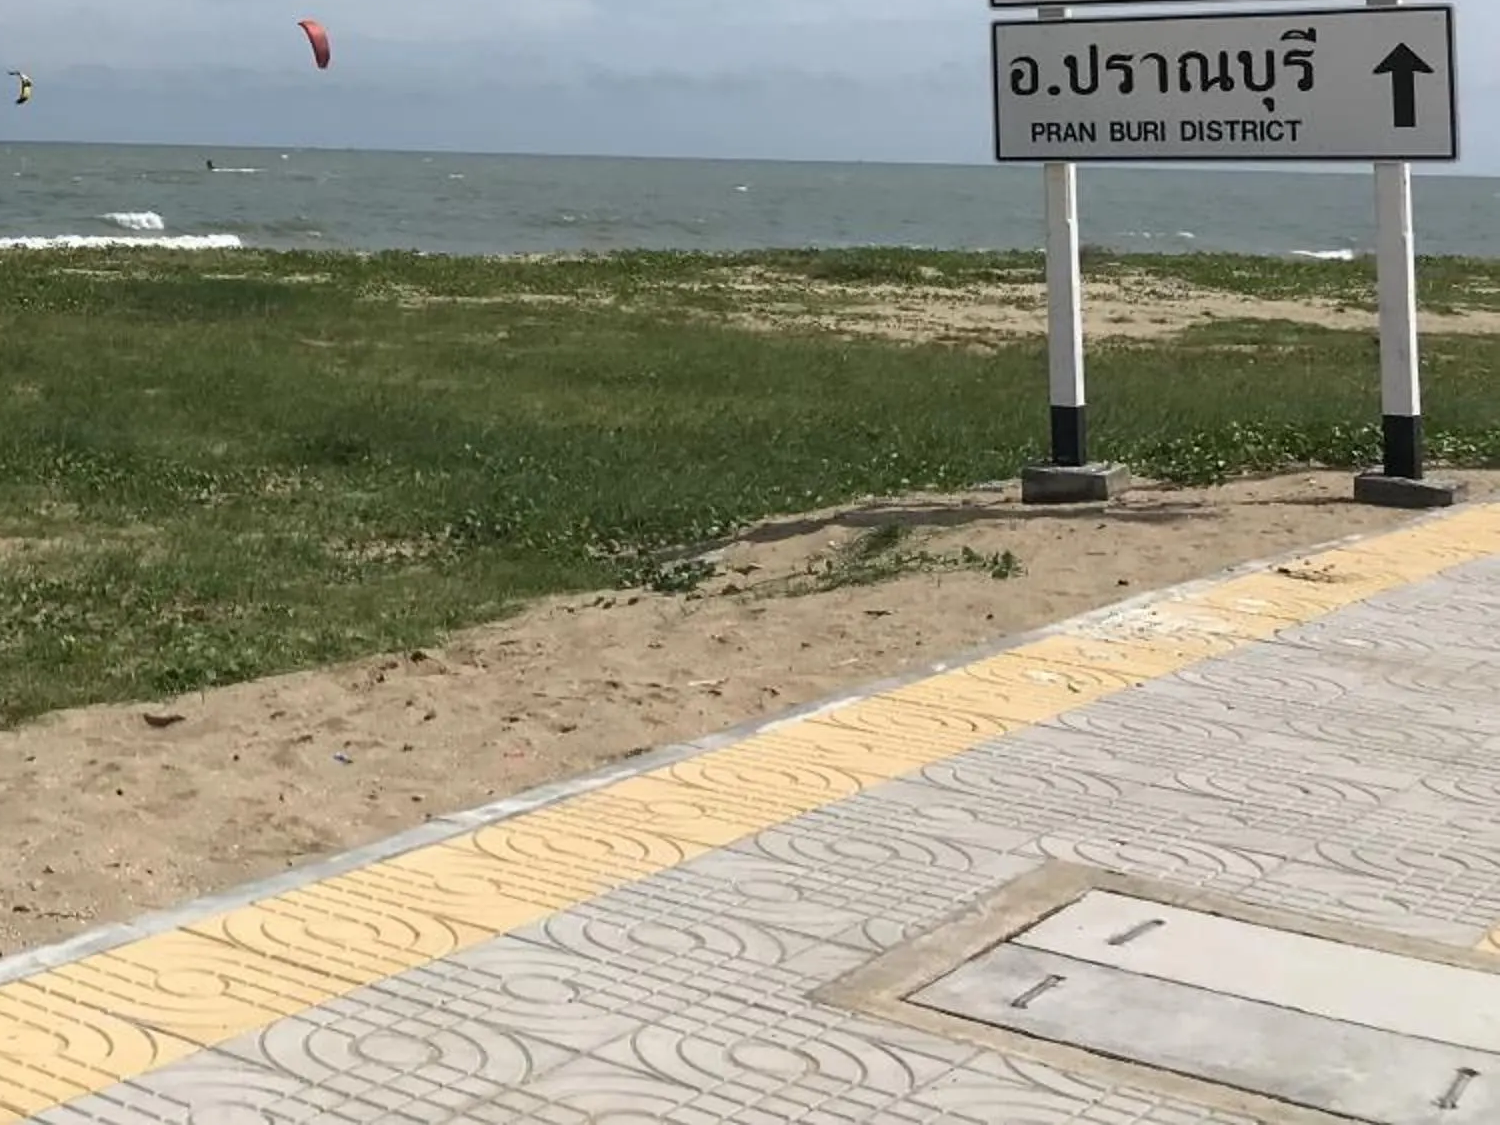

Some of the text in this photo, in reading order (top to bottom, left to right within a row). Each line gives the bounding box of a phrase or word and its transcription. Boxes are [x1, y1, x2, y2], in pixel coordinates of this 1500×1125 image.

[1009, 27, 1317, 112] อ.ปราณบุรี
[1031, 120, 1303, 143] PRAN BURI DISTRICT
